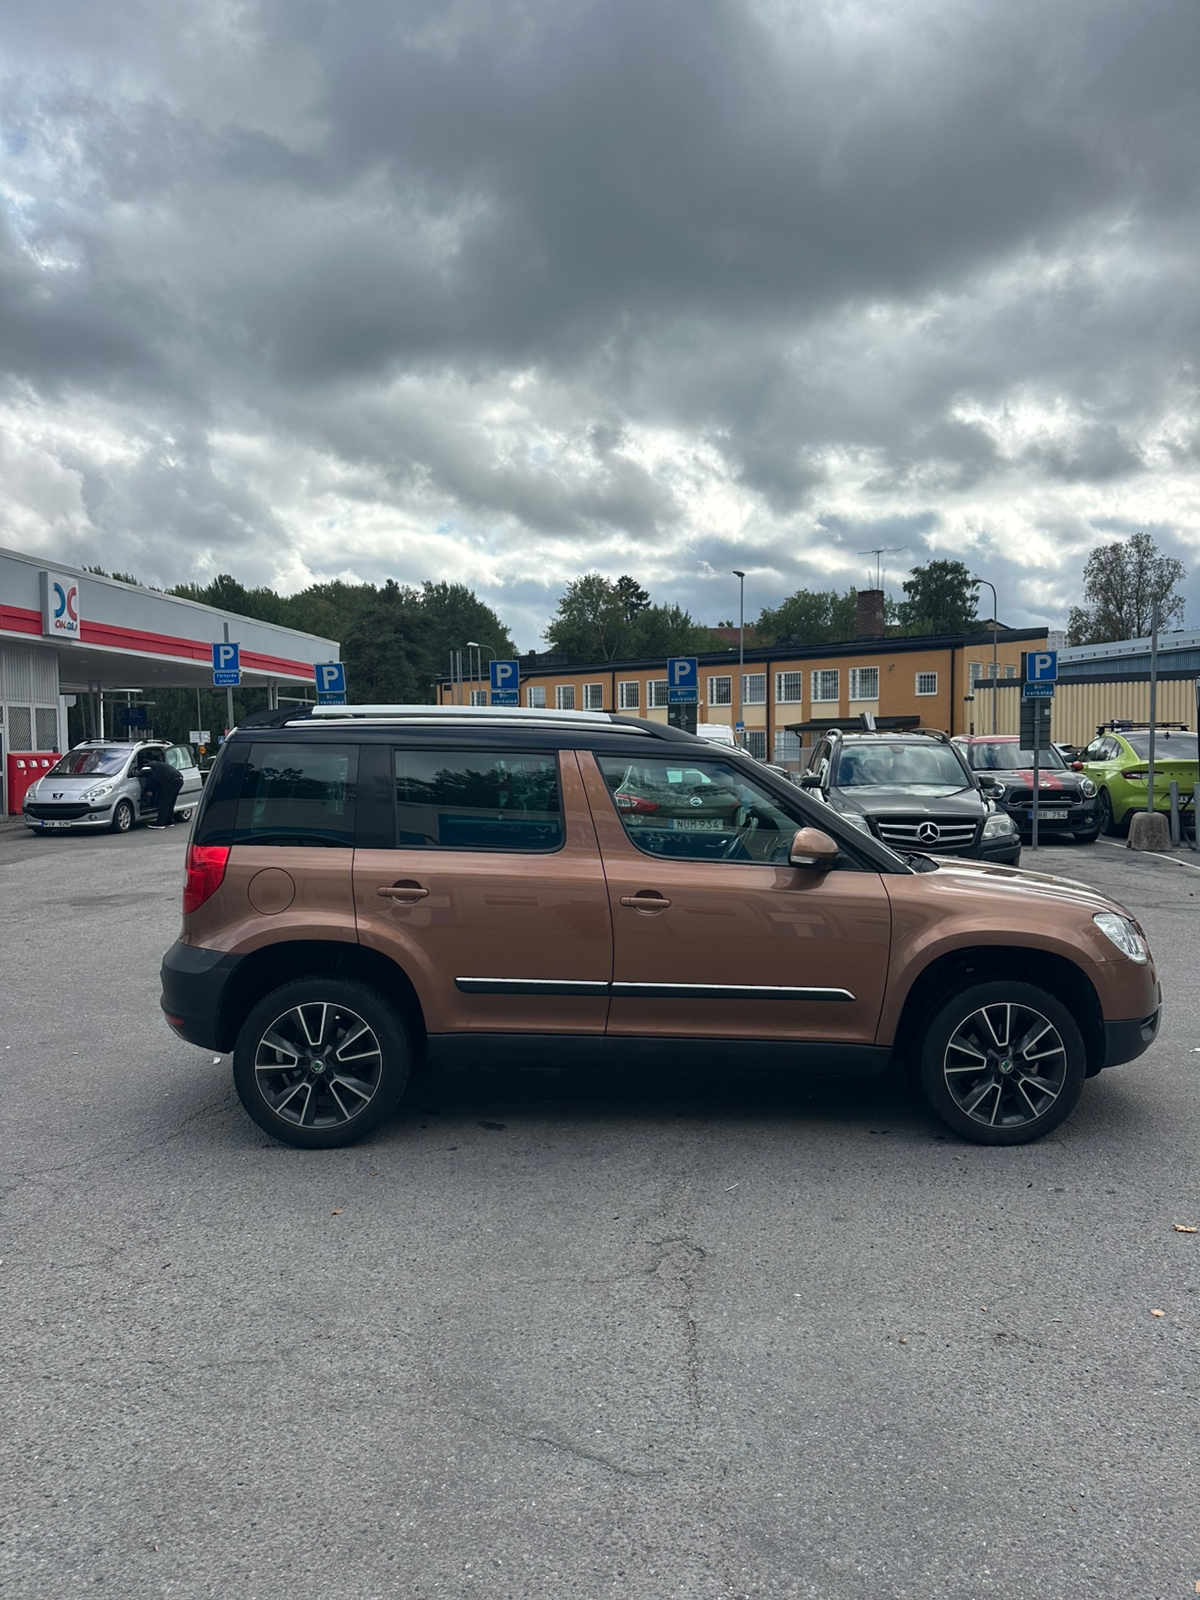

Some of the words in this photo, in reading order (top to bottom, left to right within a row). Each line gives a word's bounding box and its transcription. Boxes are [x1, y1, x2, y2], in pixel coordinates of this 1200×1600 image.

[219, 645, 234, 668] P
[1035, 654, 1052, 678] P
[322, 666, 339, 690] P
[496, 664, 512, 687] P
[674, 661, 691, 685] P
[677, 820, 697, 829] NUM
[699, 820, 719, 829] 934
[1052, 811, 1068, 819] 754
